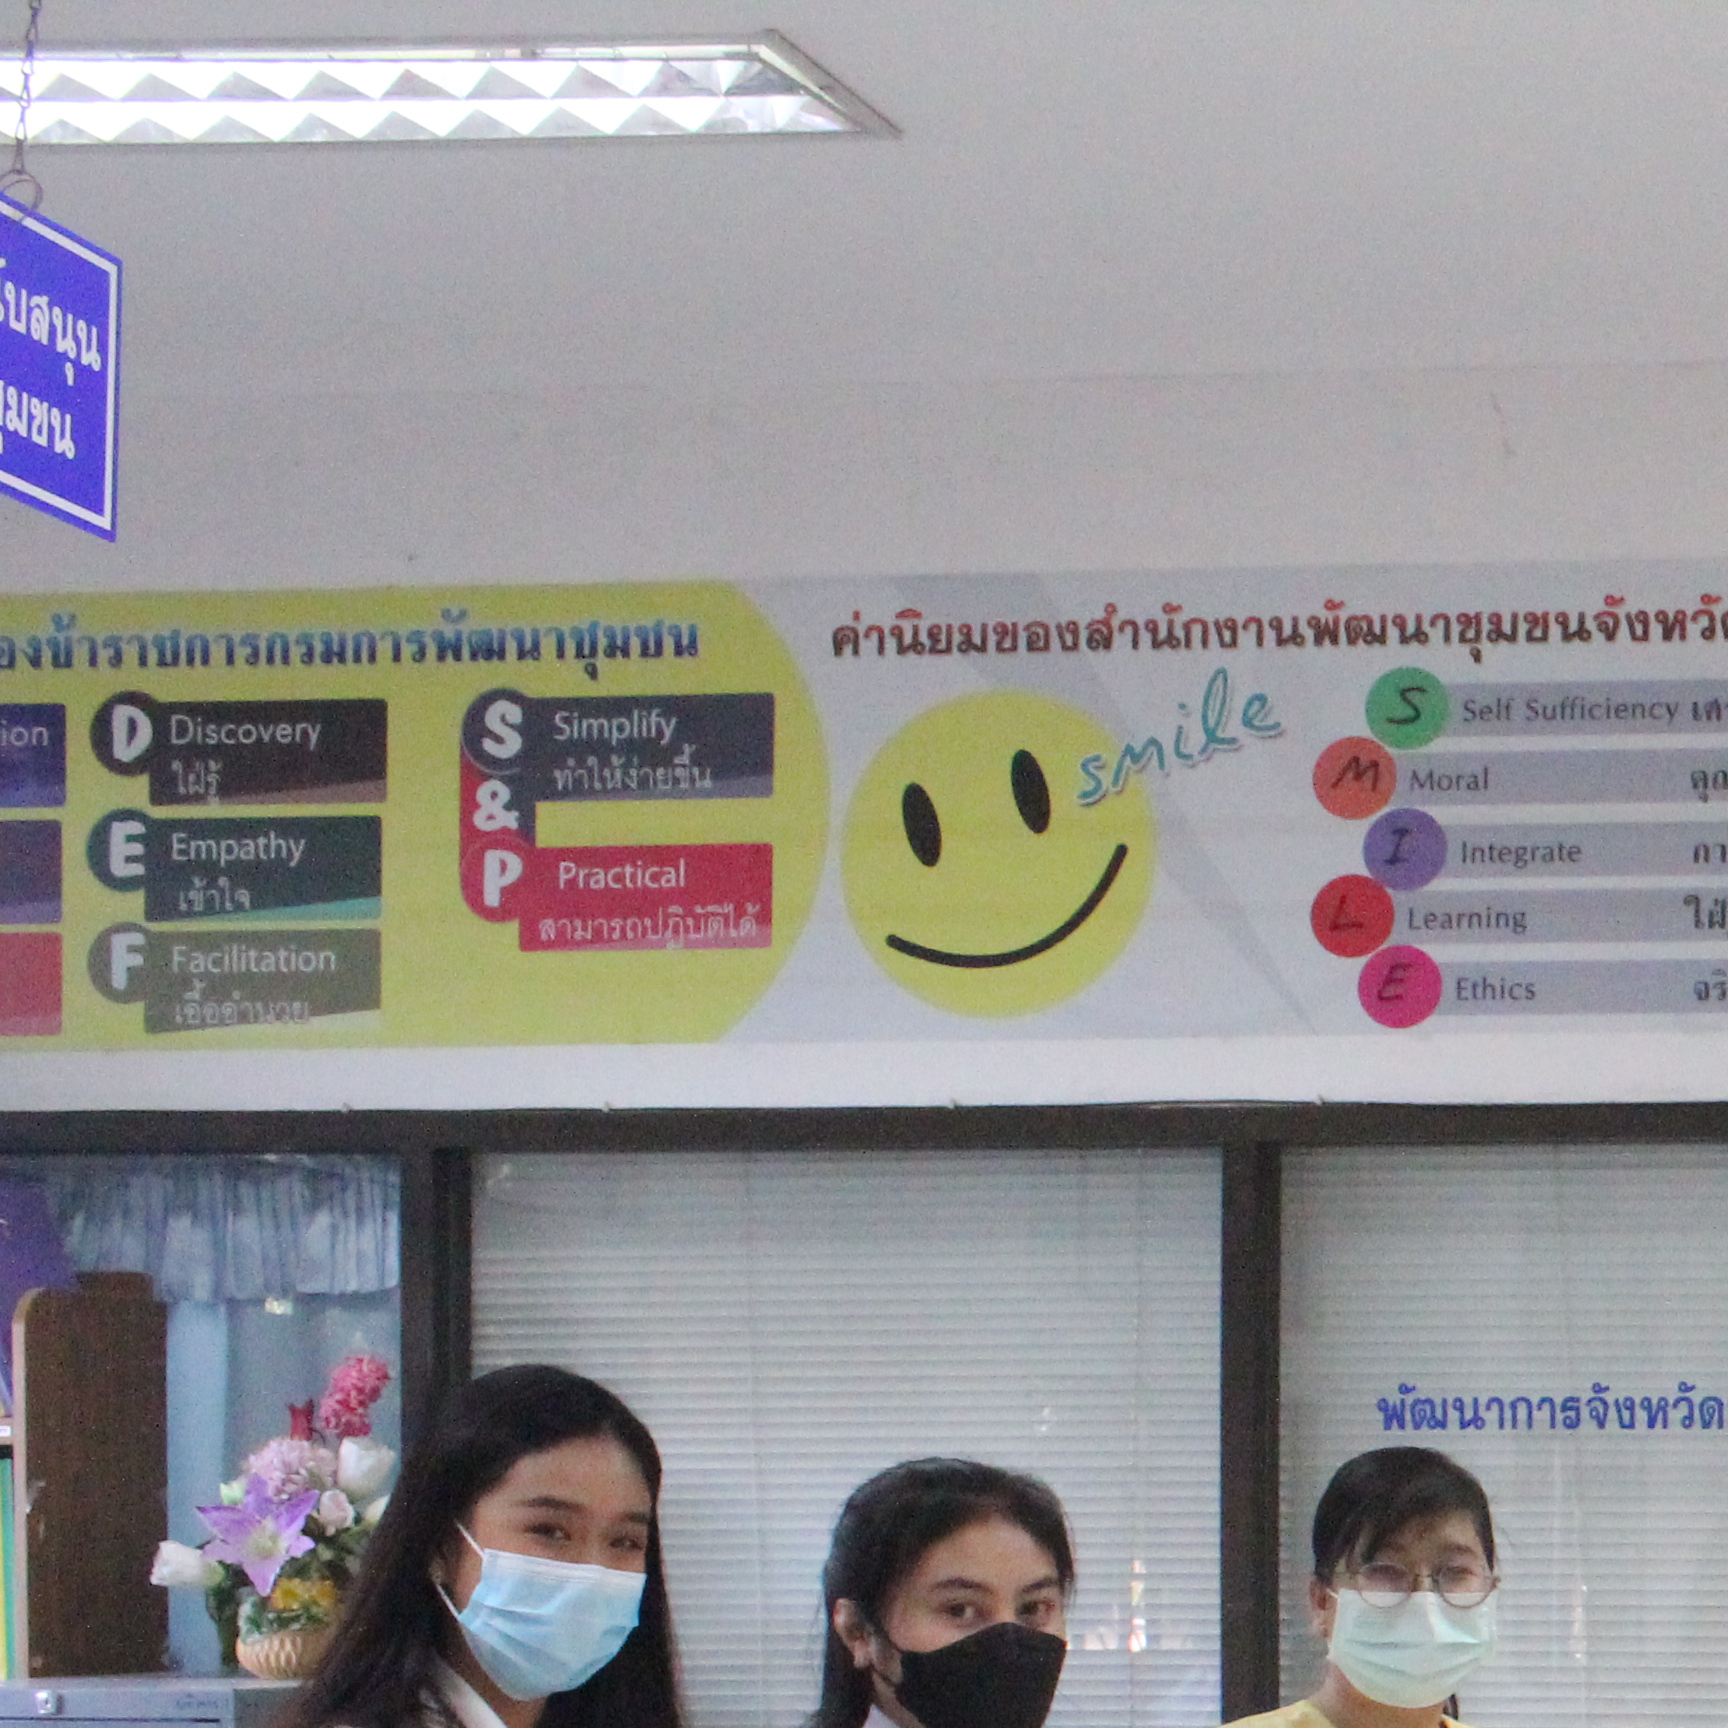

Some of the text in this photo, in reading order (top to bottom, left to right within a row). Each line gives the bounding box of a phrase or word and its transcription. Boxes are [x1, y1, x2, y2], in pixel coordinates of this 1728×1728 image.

[0, 257, 102, 386] บสนุน
[553, 707, 678, 745] Simplify
[1462, 697, 1677, 724] Self Sufficiency
[112, 704, 153, 763] D
[170, 714, 321, 750] Discovery
[482, 700, 523, 760] S
[1077, 666, 1283, 806] smile
[553, 742, 713, 793] ทำให้ง่ายขึ้น
[1409, 767, 1489, 793] Moral
[109, 820, 145, 877] E
[171, 830, 306, 867] Empathy
[1460, 840, 1582, 867] Integrate
[483, 848, 523, 907] P
[559, 858, 686, 889] Practical
[178, 876, 251, 912] เข้าใจ
[538, 902, 760, 950] สามารถปฏิบัติได้
[1407, 904, 1528, 934] Learning
[110, 932, 145, 991] F
[171, 945, 338, 975] Facilitation
[1456, 976, 1537, 1002] Ethics
